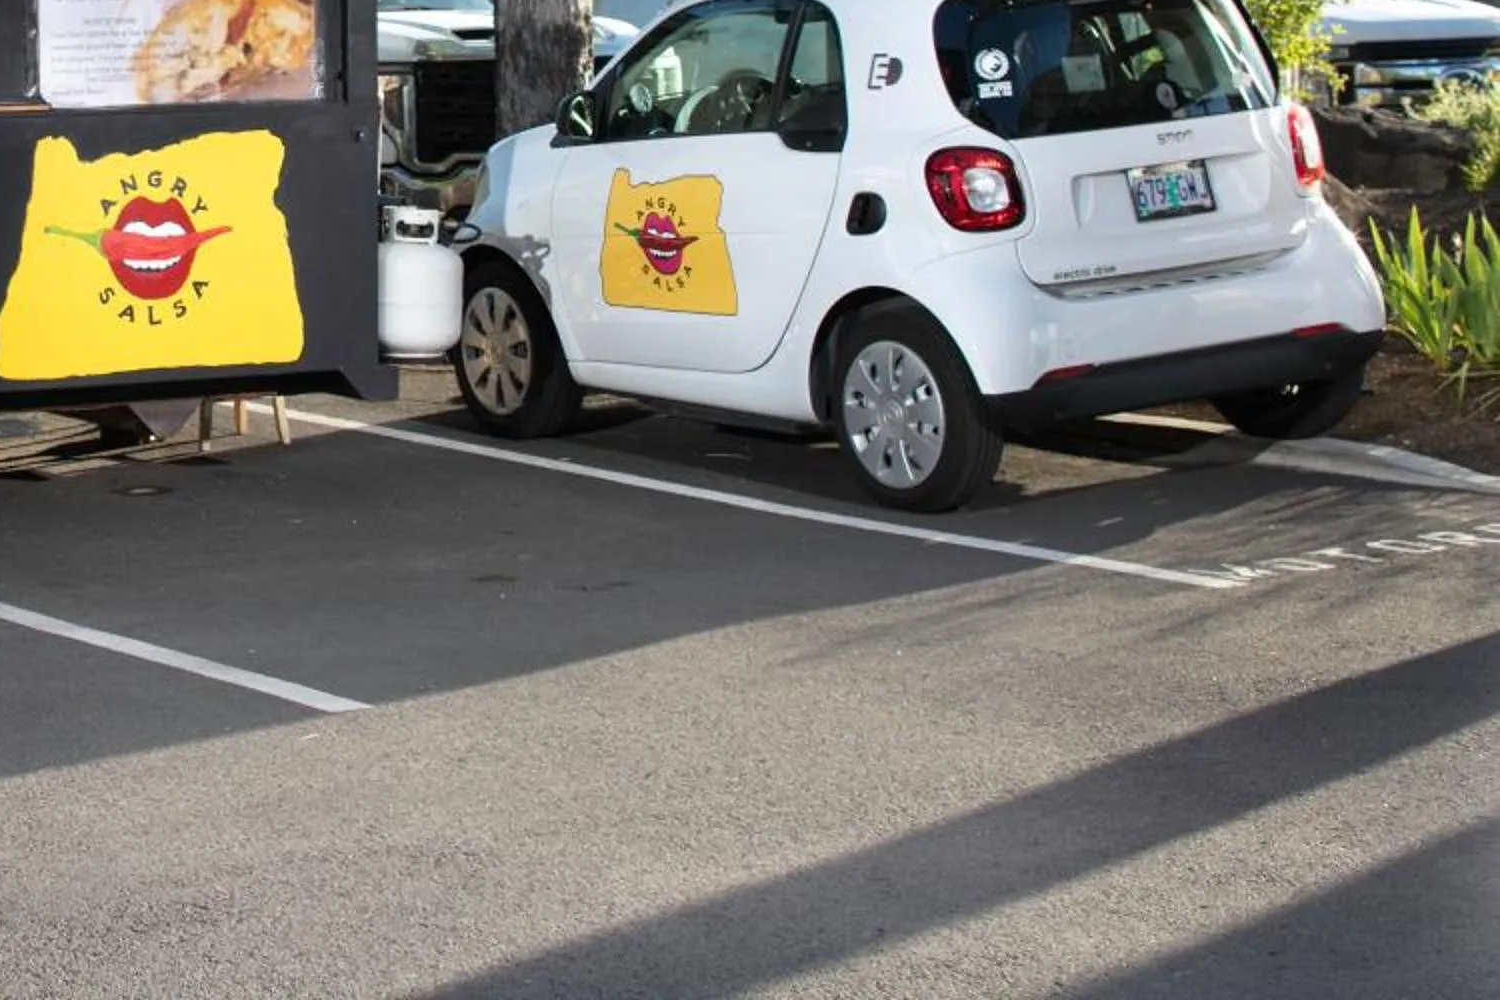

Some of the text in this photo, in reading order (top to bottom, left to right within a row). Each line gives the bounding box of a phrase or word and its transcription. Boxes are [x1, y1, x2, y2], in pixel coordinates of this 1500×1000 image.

[100, 170, 209, 217] ANGRY
[635, 197, 687, 228] ANGRY
[99, 280, 209, 325] SALSA
[1187, 523, 1500, 582] MOTOR
